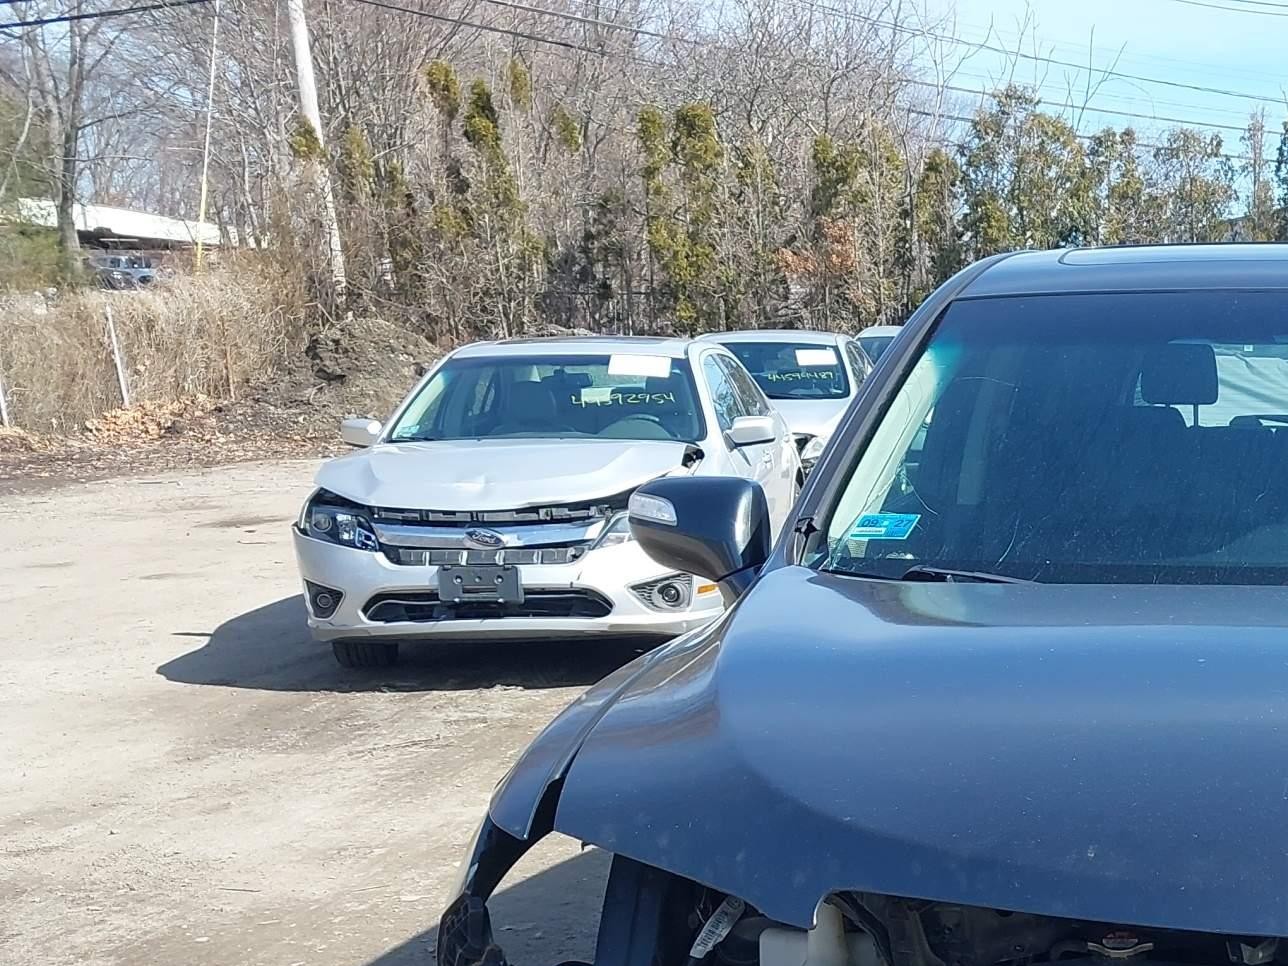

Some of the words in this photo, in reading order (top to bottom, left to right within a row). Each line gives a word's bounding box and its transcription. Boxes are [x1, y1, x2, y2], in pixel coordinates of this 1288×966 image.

[862, 518, 880, 528] 09
[894, 519, 914, 528] 27
[472, 530, 498, 544] Ford
